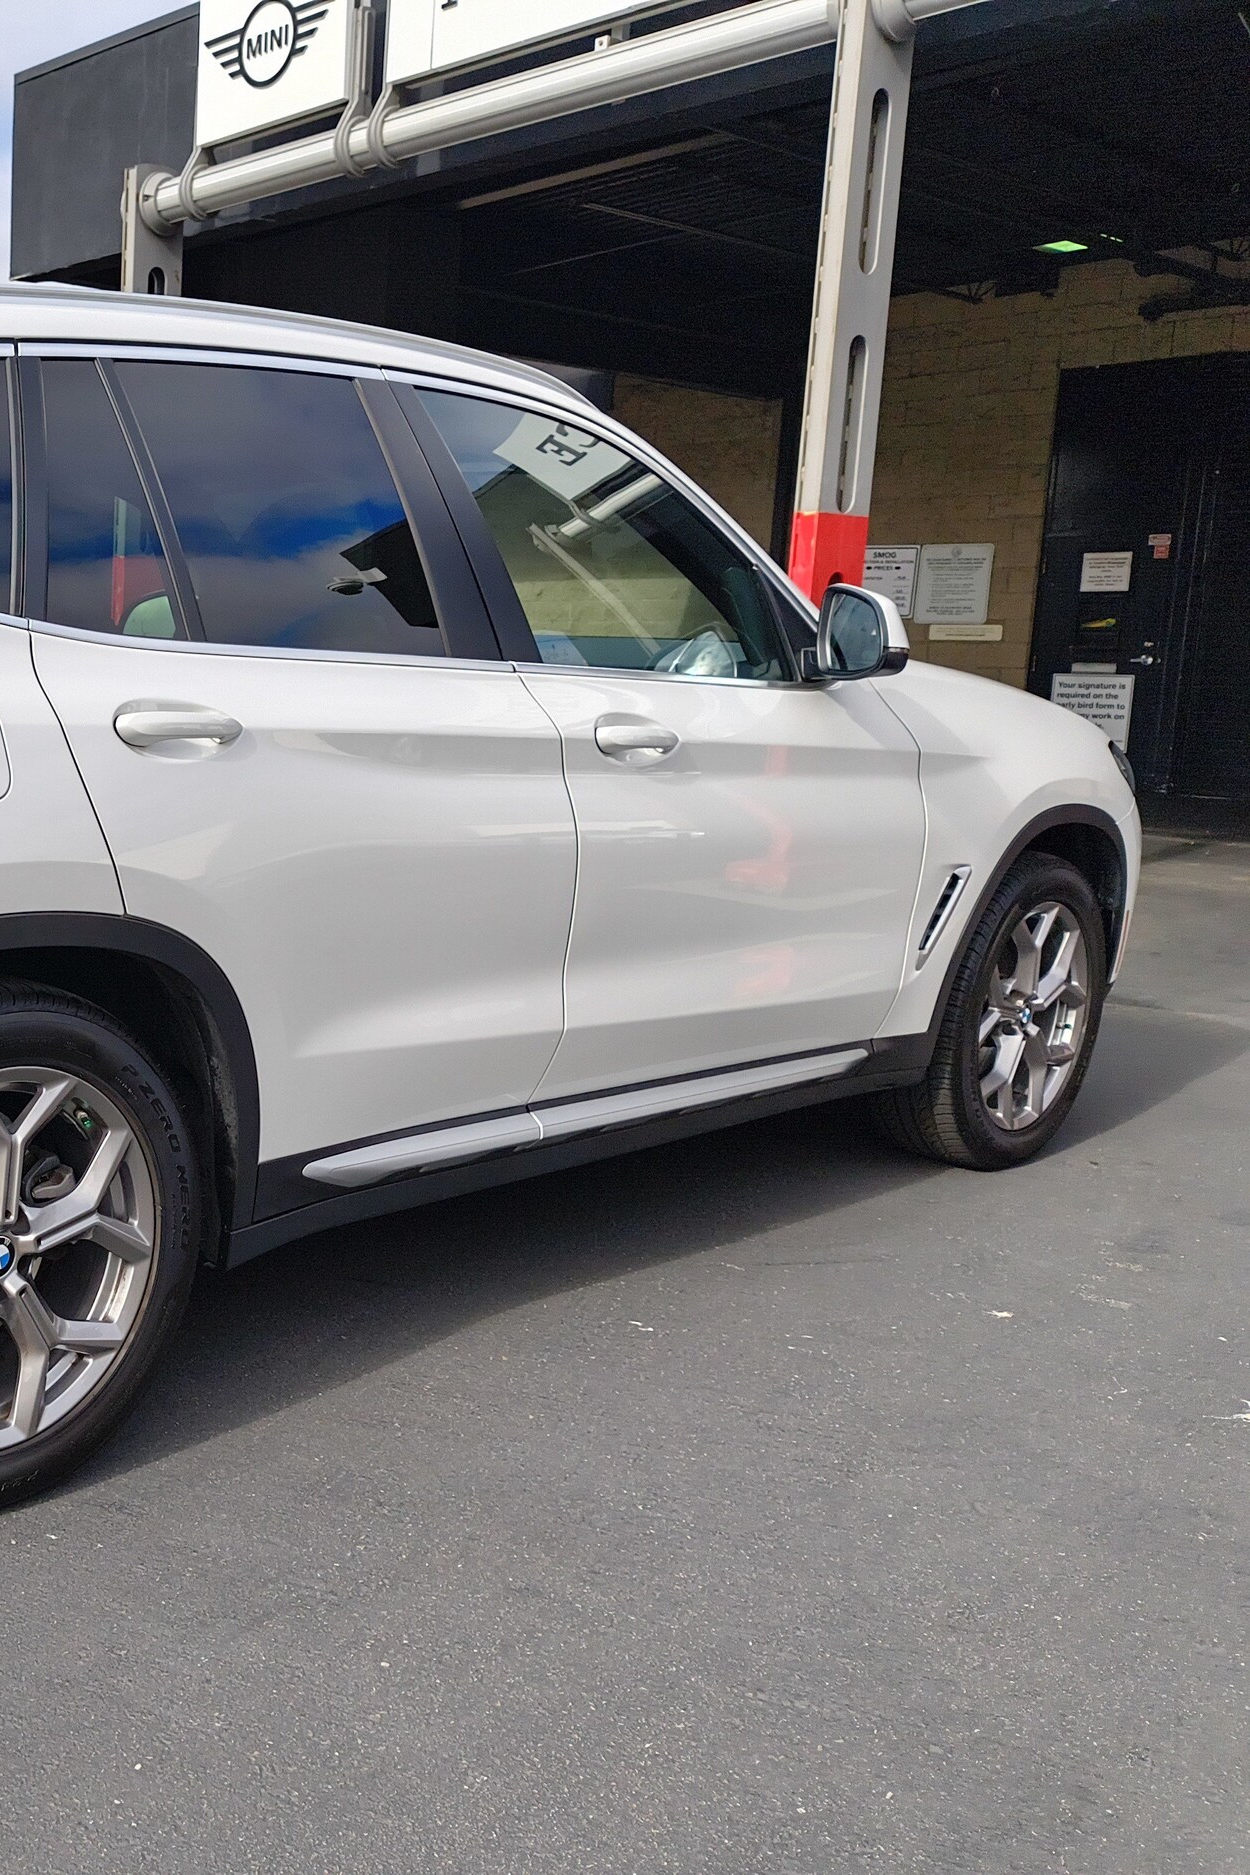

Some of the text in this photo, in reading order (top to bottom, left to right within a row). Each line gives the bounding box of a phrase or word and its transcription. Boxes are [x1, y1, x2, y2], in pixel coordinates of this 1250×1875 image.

[247, 24, 289, 60] MINI
[873, 551, 897, 559] SMOG
[1058, 681, 1076, 689] Your
[1078, 682, 1117, 690] signature
[121, 1063, 139, 1078] P
[138, 1081, 182, 1153] ZERO
[176, 1163, 190, 1248] NERO
